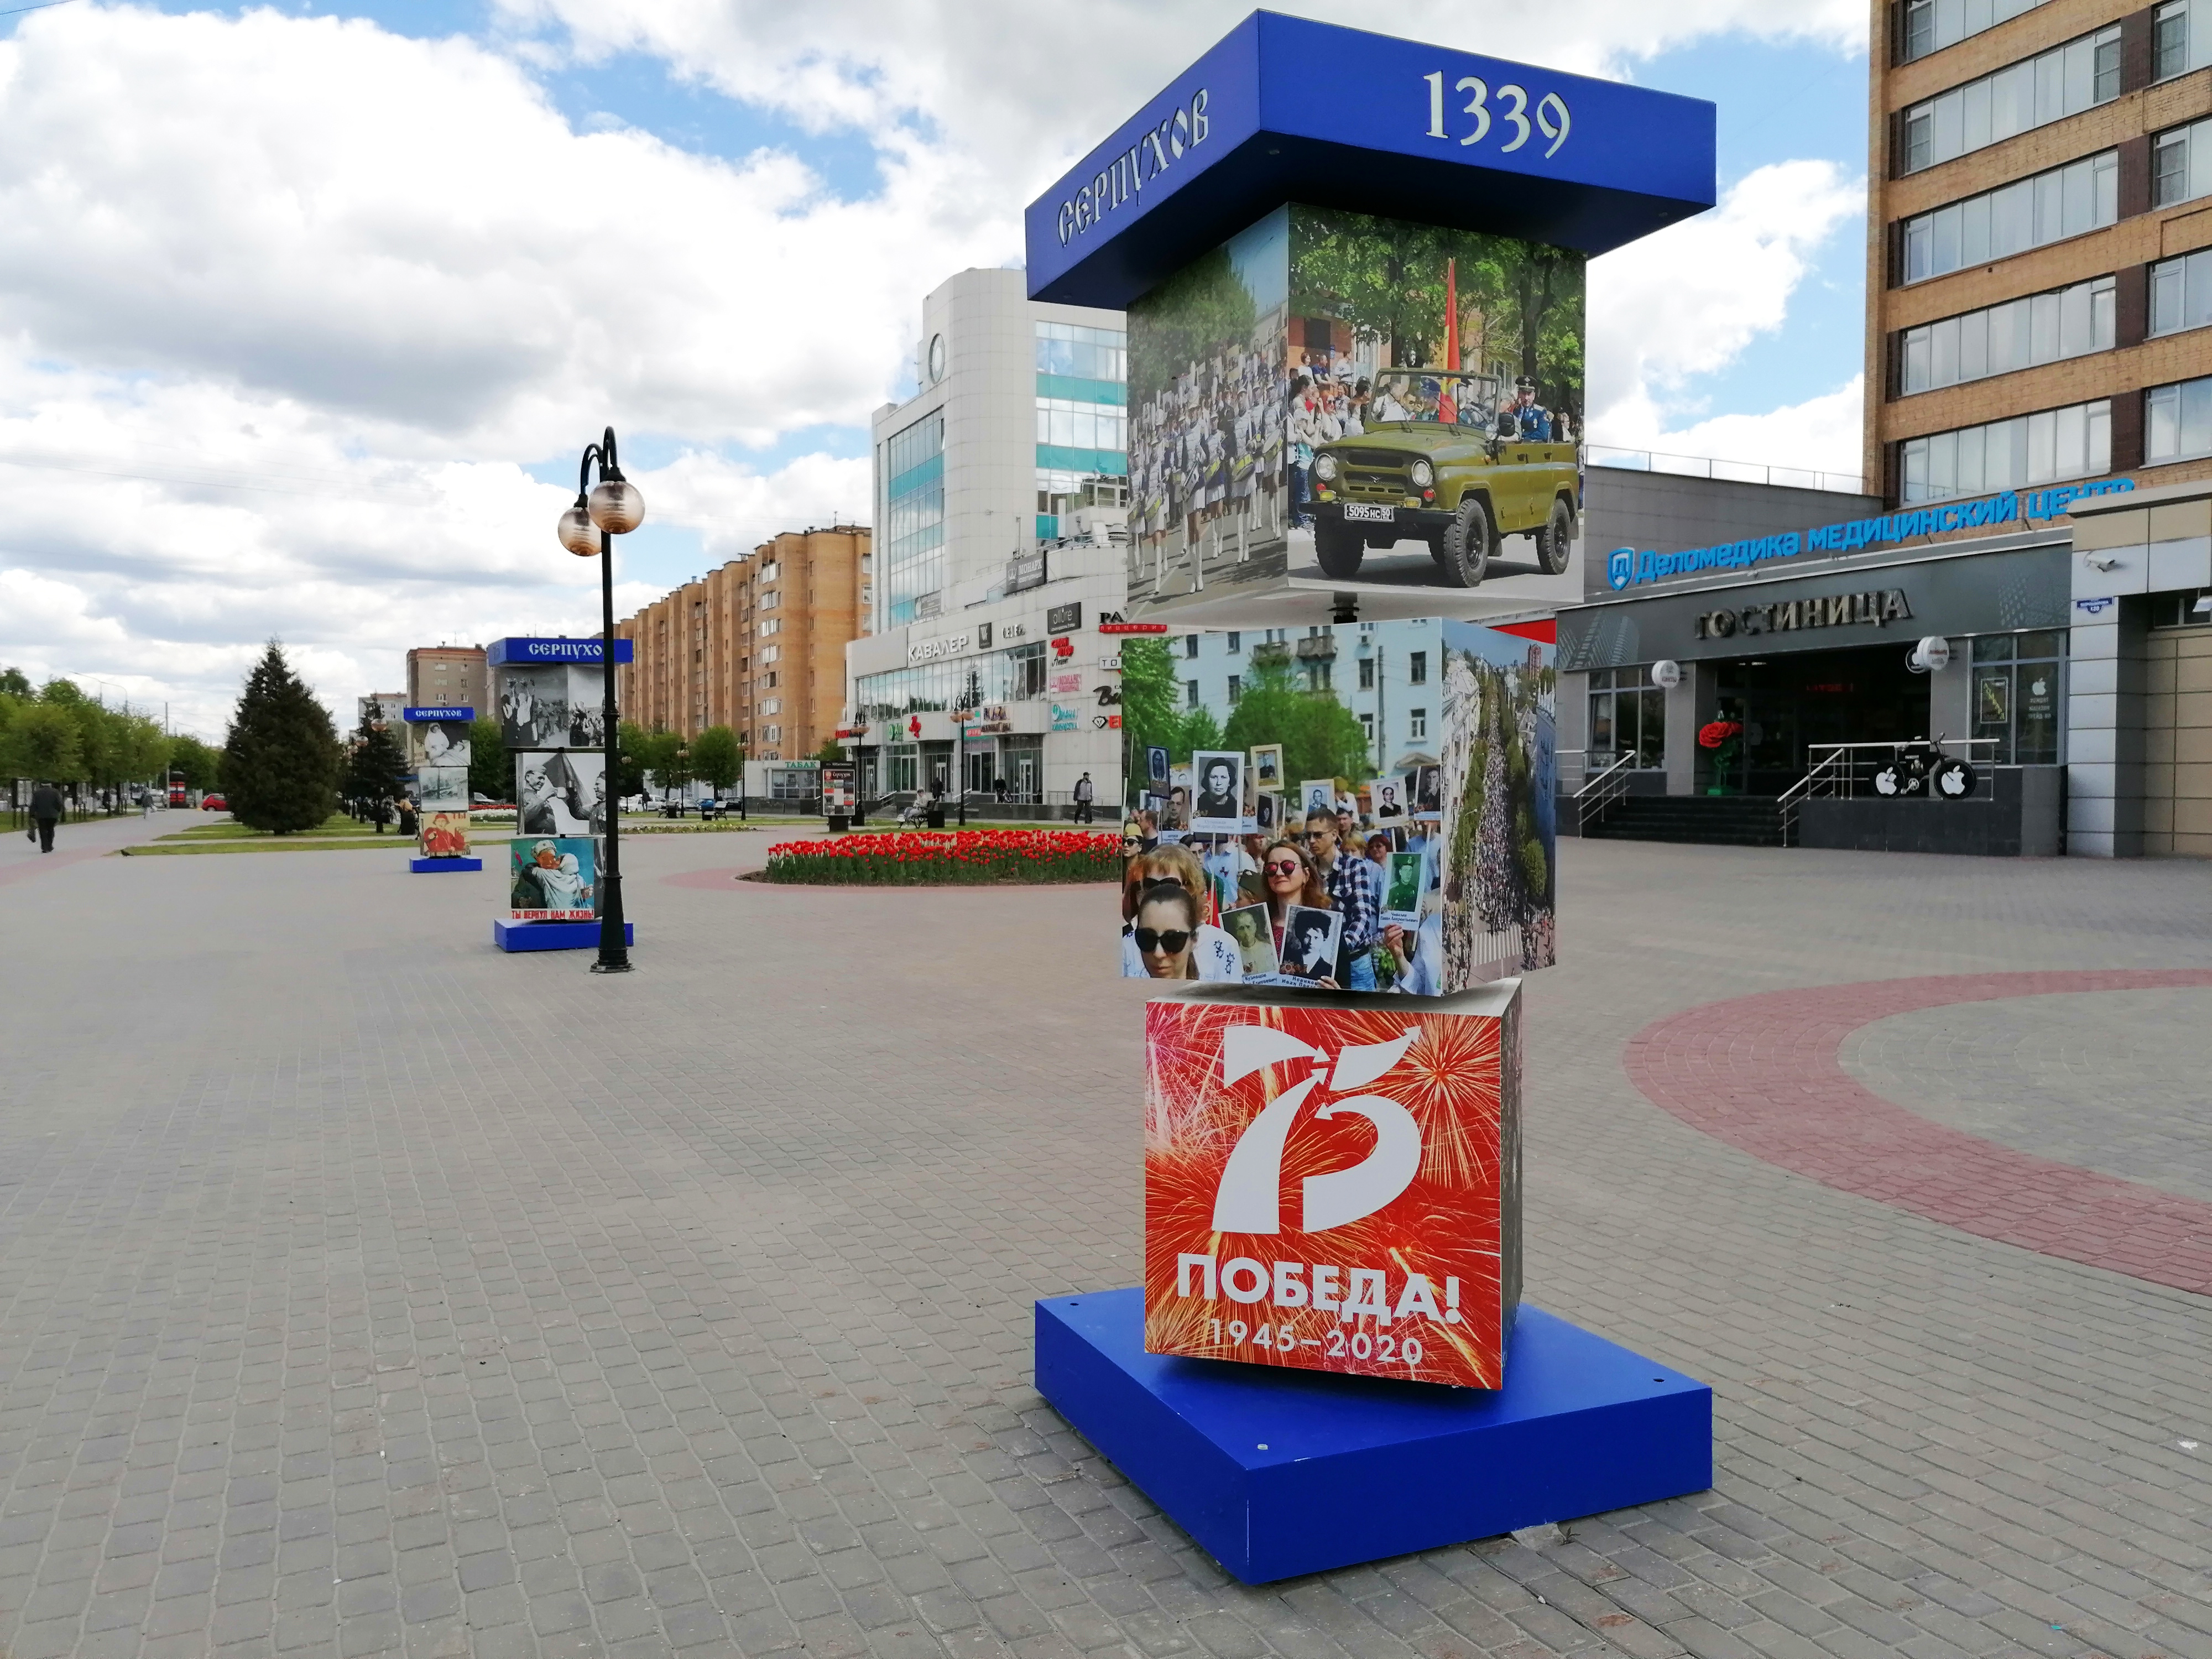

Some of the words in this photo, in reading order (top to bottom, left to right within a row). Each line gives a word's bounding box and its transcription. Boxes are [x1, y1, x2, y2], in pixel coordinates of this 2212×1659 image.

[1423, 70, 1572, 160] 1339
[1635, 530, 1800, 583] Деломедика
[1808, 490, 2018, 552] МЕДИЦИНСКИЙ
[1018, 558, 1042, 576] МОНАРХ
[1695, 588, 1916, 640] ГОСТИНИЦА
[907, 635, 969, 662] КАВАЛЕР
[415, 709, 462, 718] СЕРПУХОВ
[512, 910, 521, 919] ТЫ
[524, 910, 547, 919] ВЕРНУЛ
[551, 910, 565, 919] НАМ
[568, 910, 594, 920] ЖИЗНЬ!
[1212, 1024, 1422, 1234] 75
[1177, 1252, 1462, 1326] ПОБЕДА!
